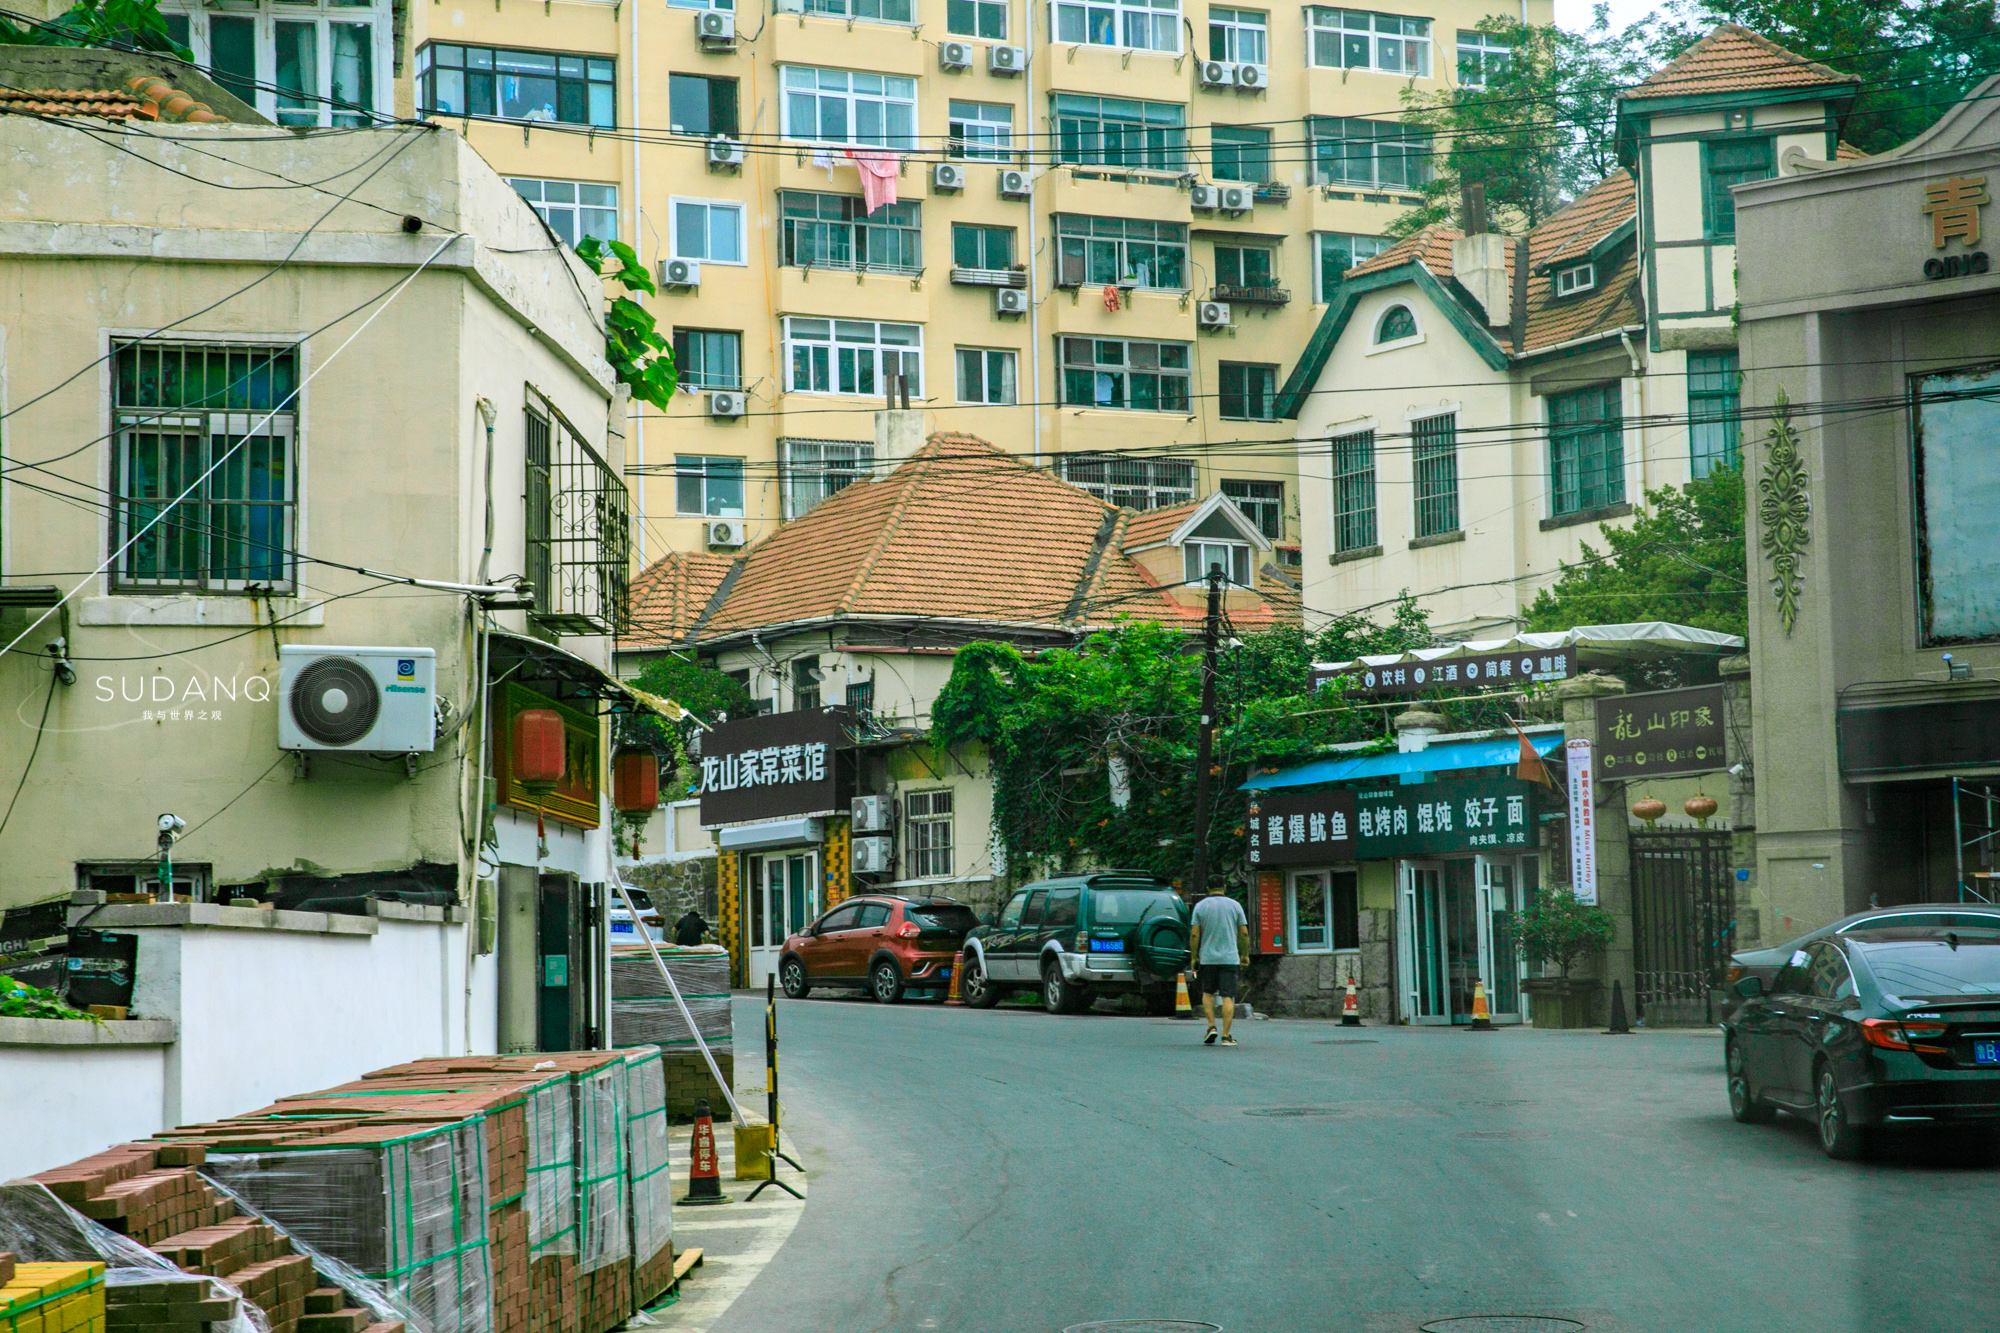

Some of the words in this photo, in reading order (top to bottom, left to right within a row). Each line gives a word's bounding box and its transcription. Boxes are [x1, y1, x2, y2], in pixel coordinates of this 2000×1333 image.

[1921, 176, 1991, 248] 青
[385, 684, 426, 693] Hisense
[1381, 668, 1406, 686] 饮料
[1485, 660, 1512, 678] 简餐
[1540, 654, 1567, 673] 咖啡
[700, 742, 829, 794] 龙山家常菜馆
[1268, 811, 1348, 845] 酱爆鱿鱼
[1359, 805, 1408, 837] 电烤肉
[1416, 801, 1453, 834] 馄饨
[1464, 797, 1499, 829] 饺子
[1506, 795, 1524, 826] 面
